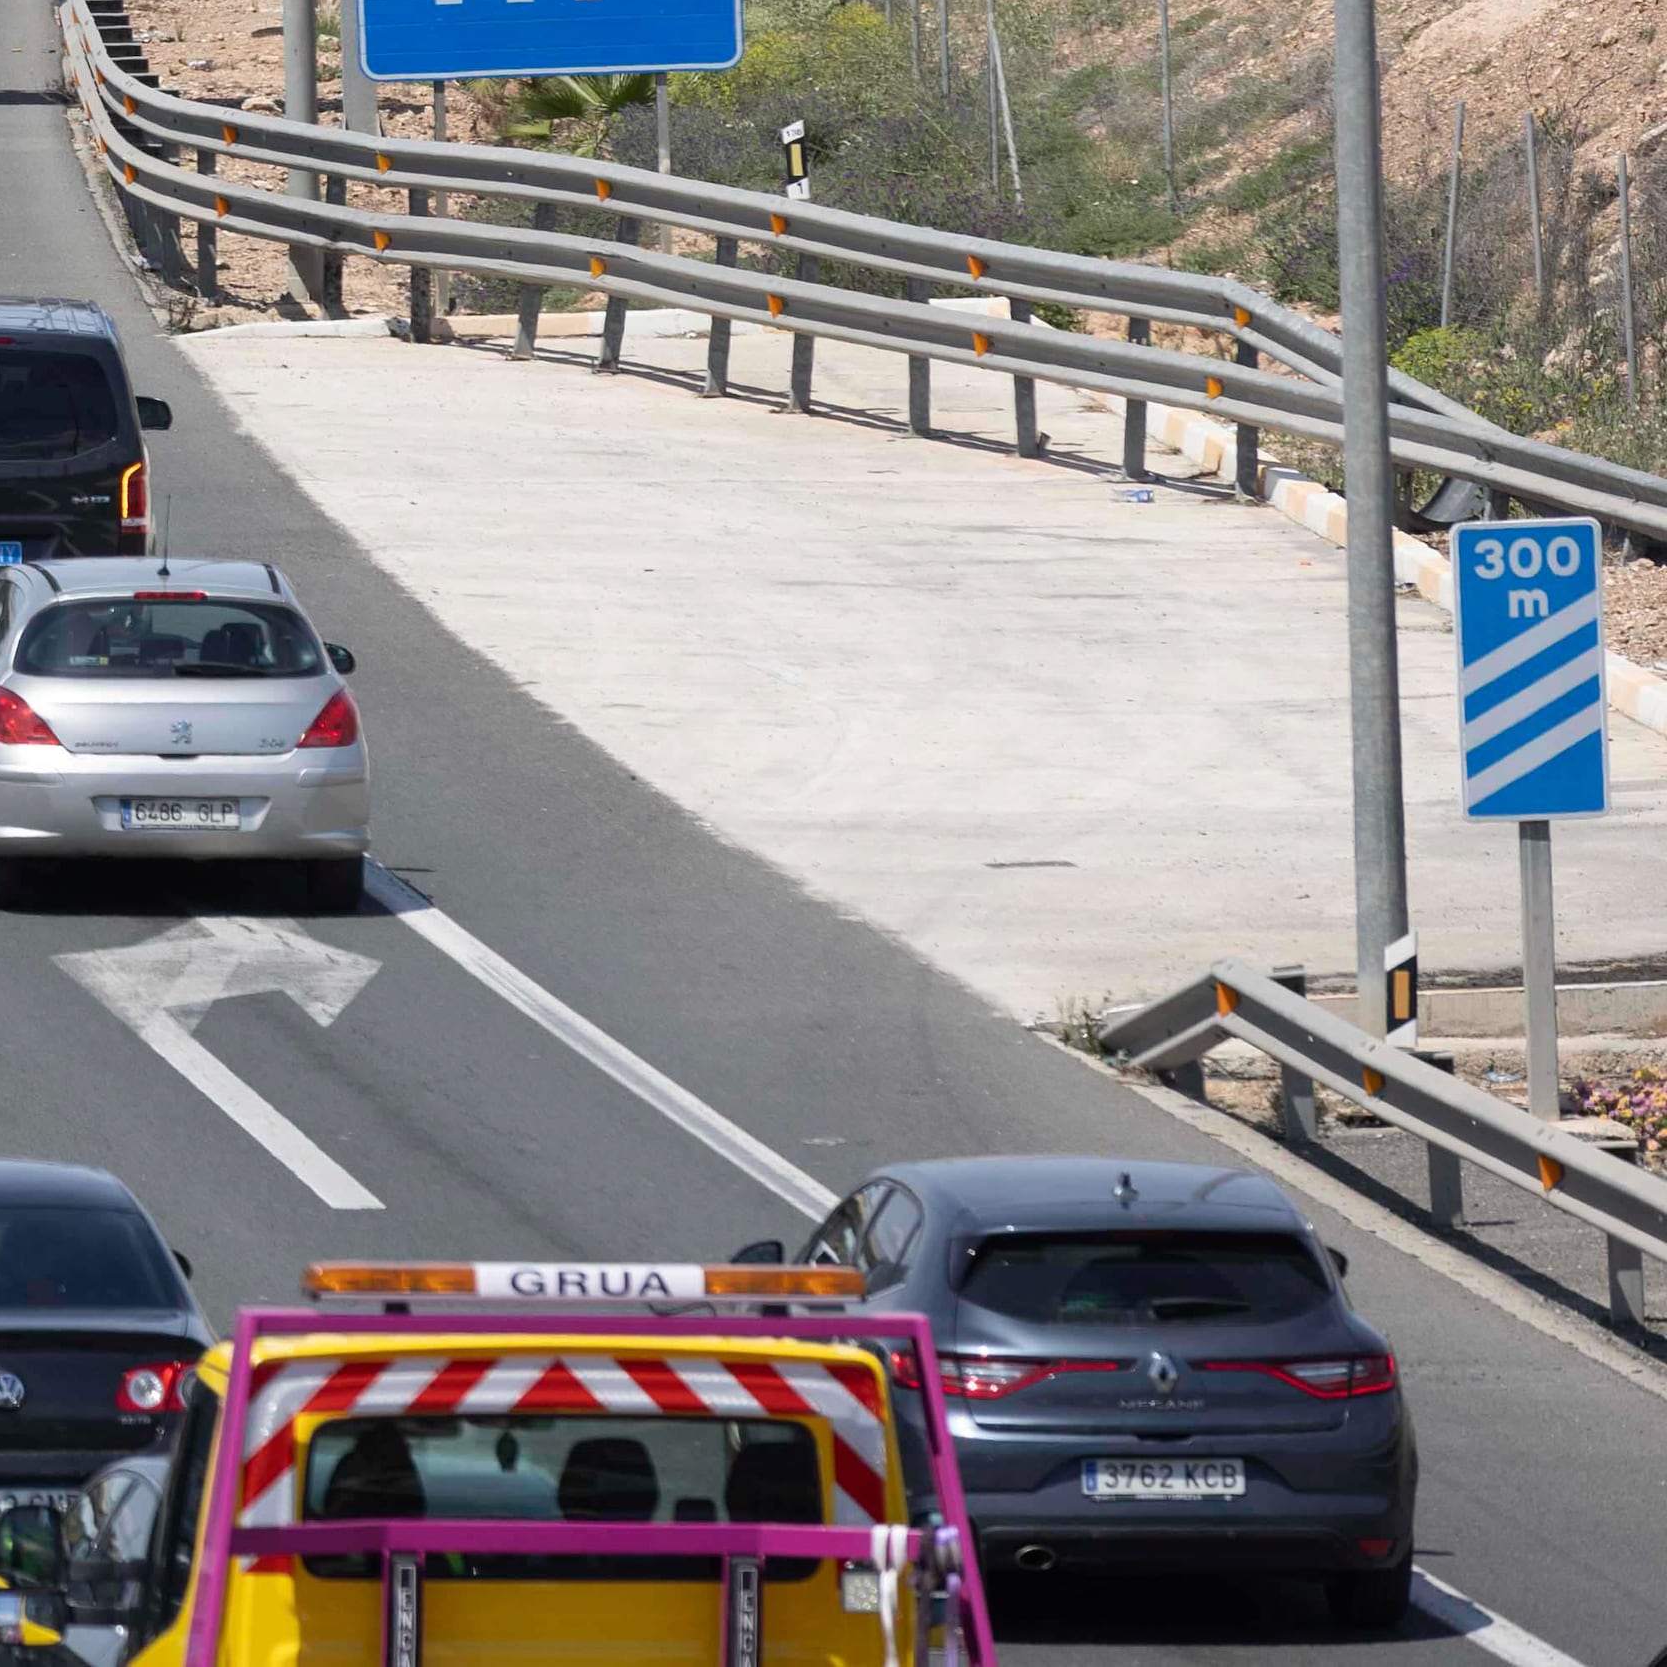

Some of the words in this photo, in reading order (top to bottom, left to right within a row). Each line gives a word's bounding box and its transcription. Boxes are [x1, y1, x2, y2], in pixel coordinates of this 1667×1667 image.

[1473, 536, 1581, 580] 300
[1508, 588, 1549, 619] m
[135, 802, 183, 822] 6486
[198, 803, 234, 822] GLP
[510, 1270, 673, 1297] GRUA
[1104, 1463, 1174, 1489] 3762
[1184, 1462, 1237, 1489] KCB
